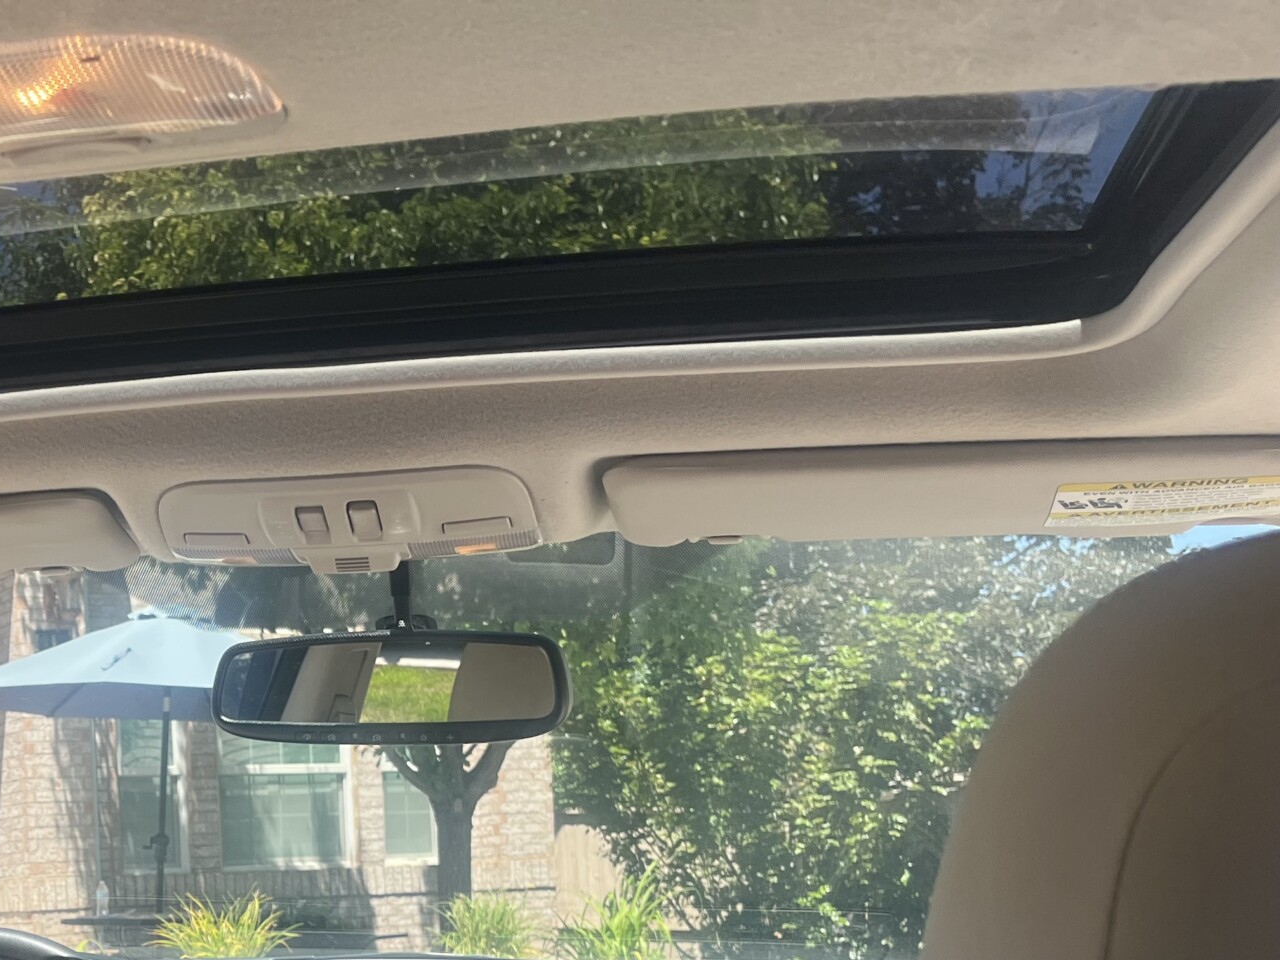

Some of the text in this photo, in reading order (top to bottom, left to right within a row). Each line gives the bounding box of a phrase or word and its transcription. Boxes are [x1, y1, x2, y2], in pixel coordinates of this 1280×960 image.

[1132, 478, 1249, 489] WARNING
[1153, 486, 1221, 494] ADVANCED
[1087, 500, 1276, 517] AVERTISSEMENT
